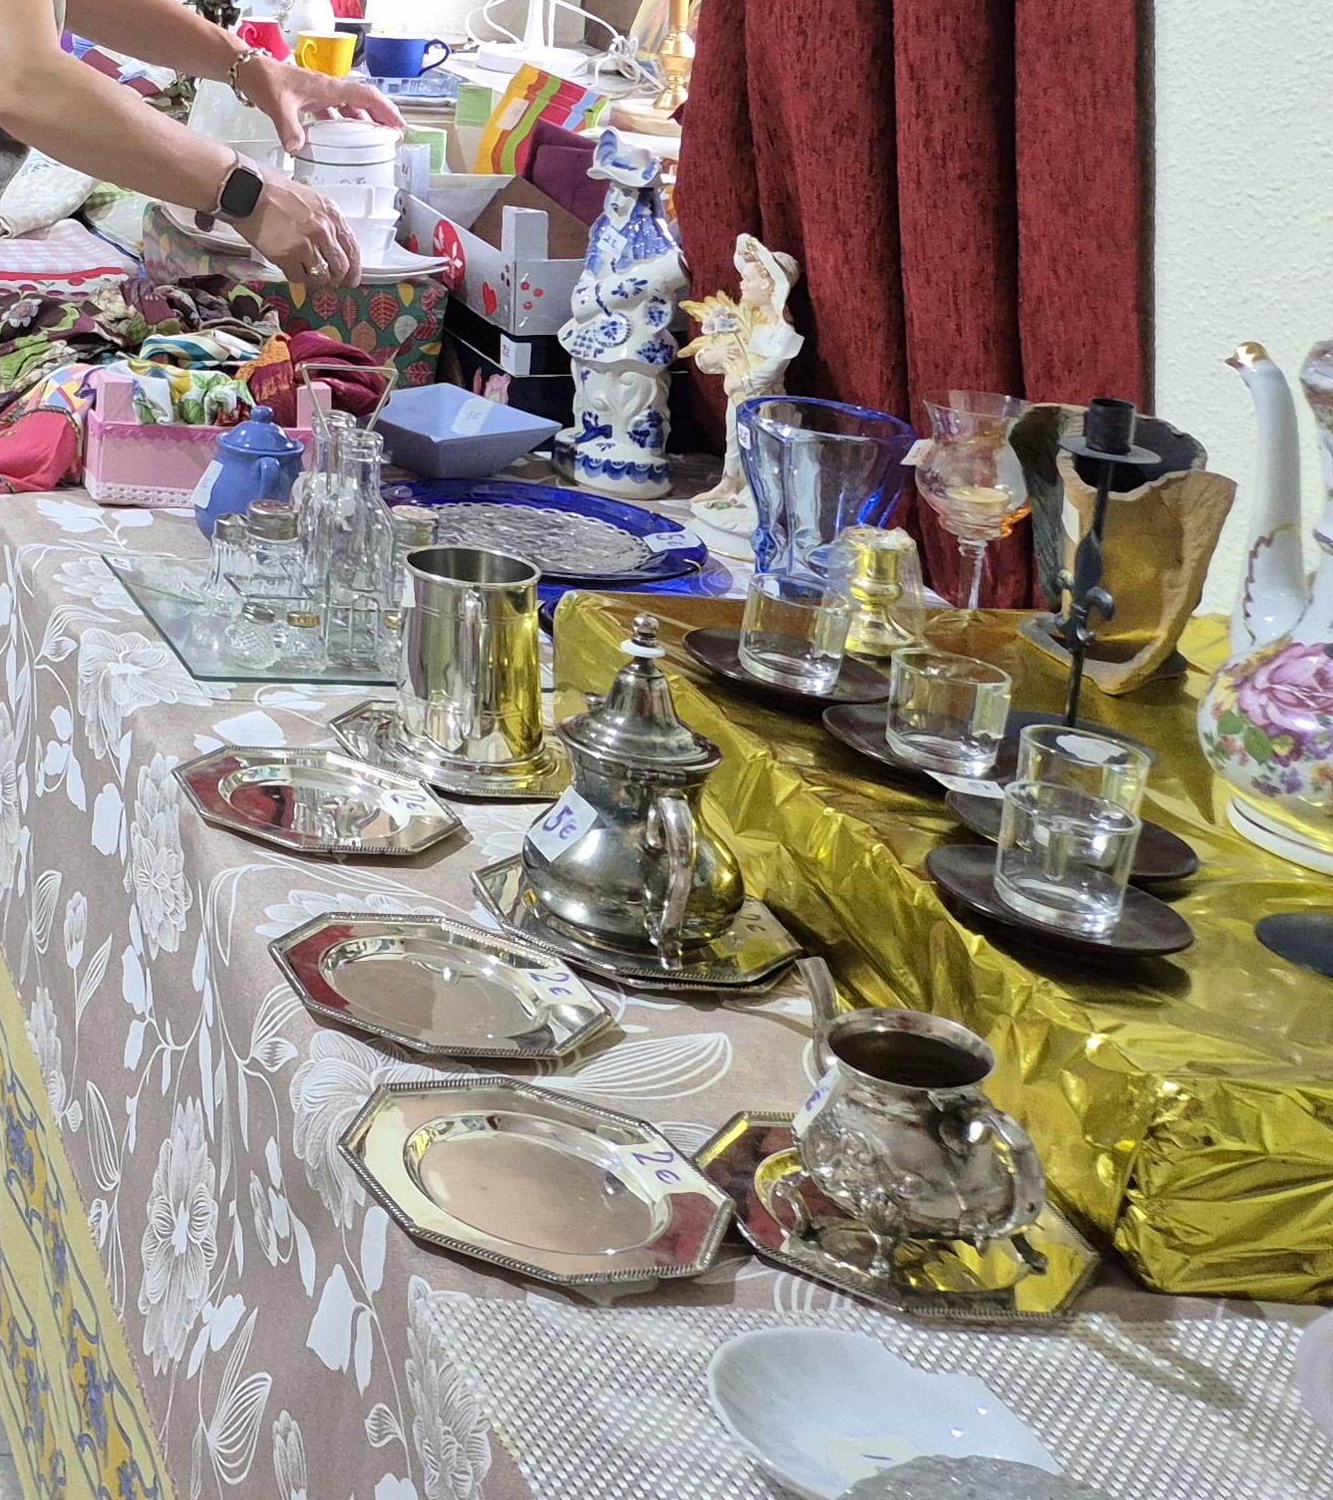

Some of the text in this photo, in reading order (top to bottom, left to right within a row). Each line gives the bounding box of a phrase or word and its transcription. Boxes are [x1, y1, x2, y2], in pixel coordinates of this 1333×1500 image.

[542, 804, 577, 840] 5€
[528, 971, 573, 996] 2€
[631, 1150, 682, 1185] 2€
